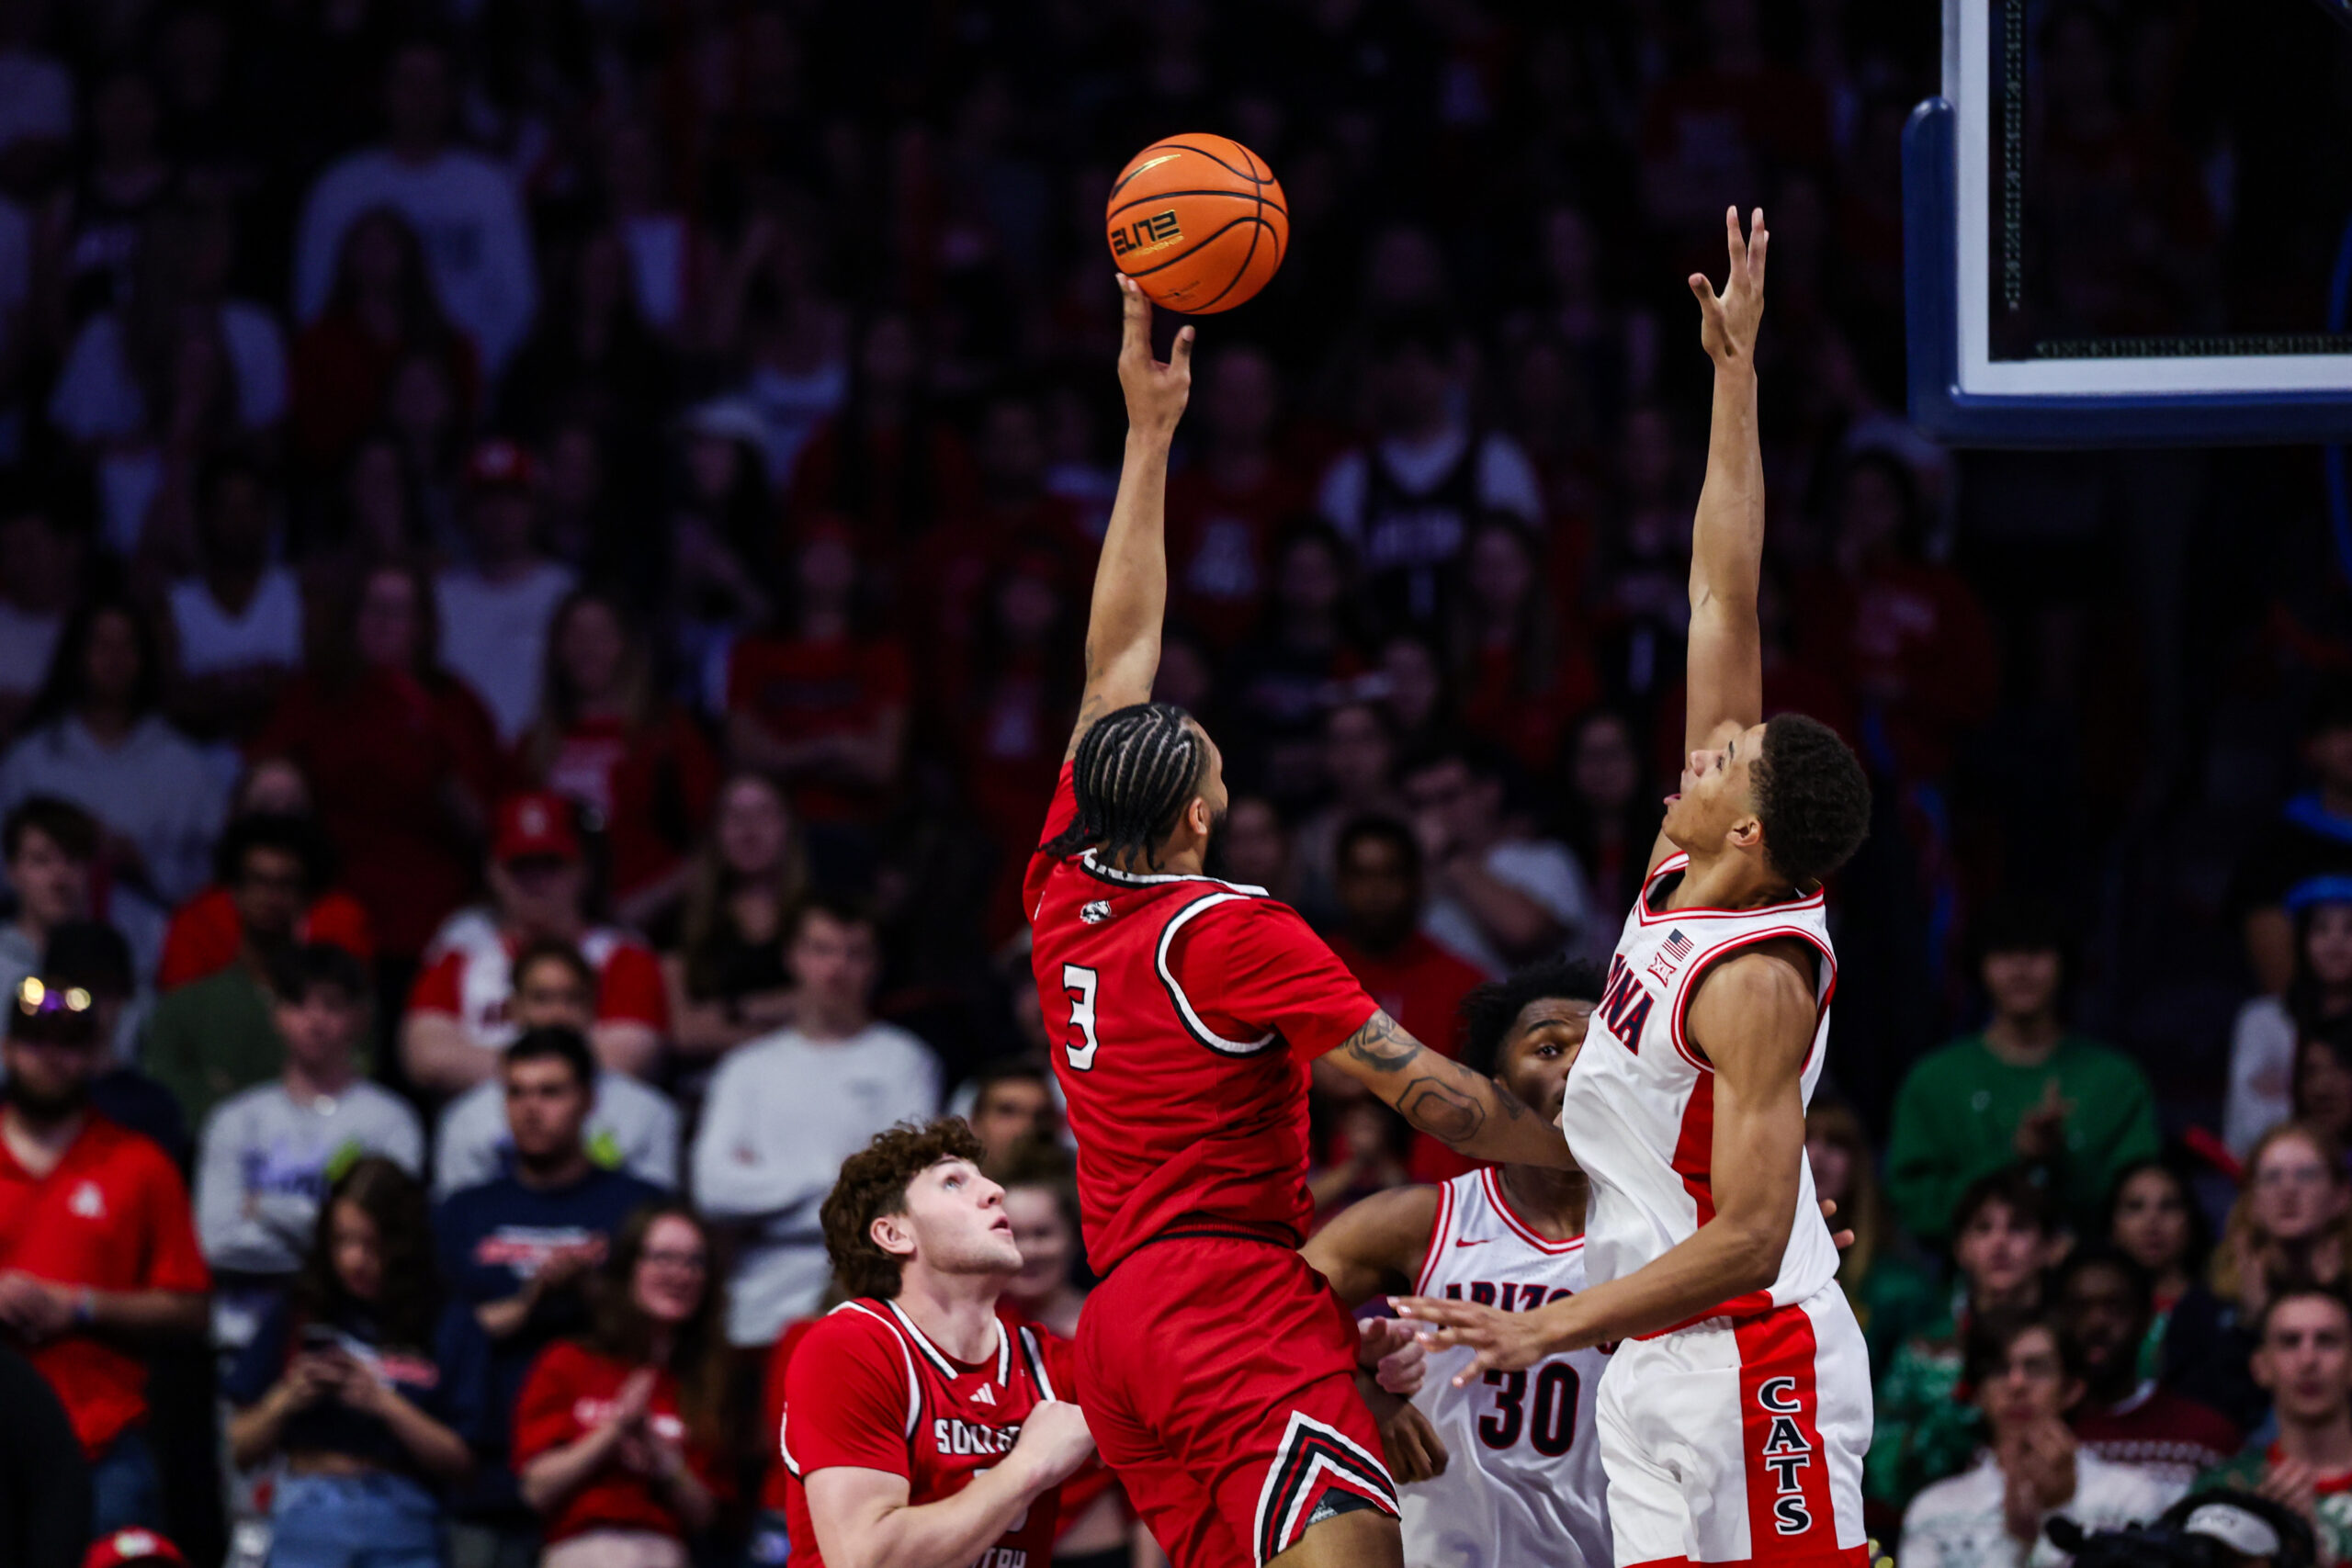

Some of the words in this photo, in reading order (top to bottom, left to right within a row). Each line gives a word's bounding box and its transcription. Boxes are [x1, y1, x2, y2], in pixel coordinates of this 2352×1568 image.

[1111, 210, 1181, 256] ELITE
[1062, 962, 1099, 1072] 3
[1478, 1361, 1580, 1458] 30
[1758, 1376, 1812, 1536] CATS
